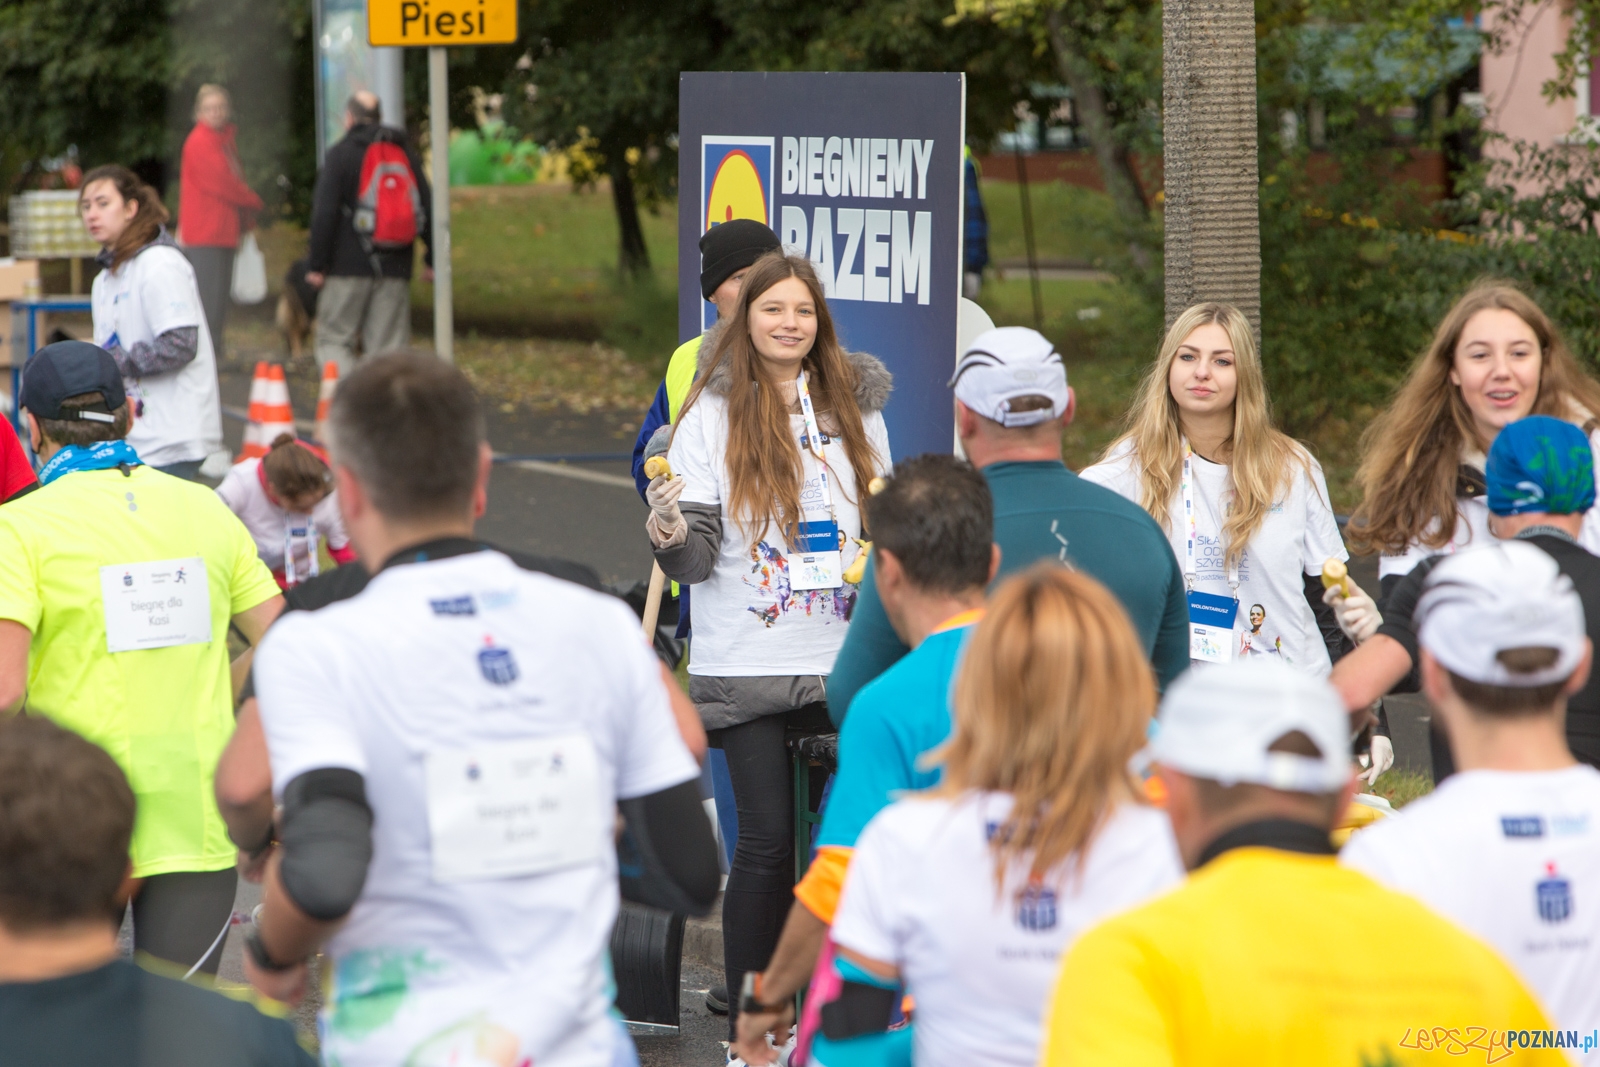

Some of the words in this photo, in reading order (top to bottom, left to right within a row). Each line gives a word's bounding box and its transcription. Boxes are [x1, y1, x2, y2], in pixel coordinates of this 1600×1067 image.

[401, 0, 485, 37] Piesi
[781, 135, 935, 200] BIEGNIEMY
[131, 600, 165, 613] biegnę
[167, 597, 183, 608] dla
[1190, 603, 1229, 614] WOLONTARIUSZ
[148, 614, 170, 626] Kasi
